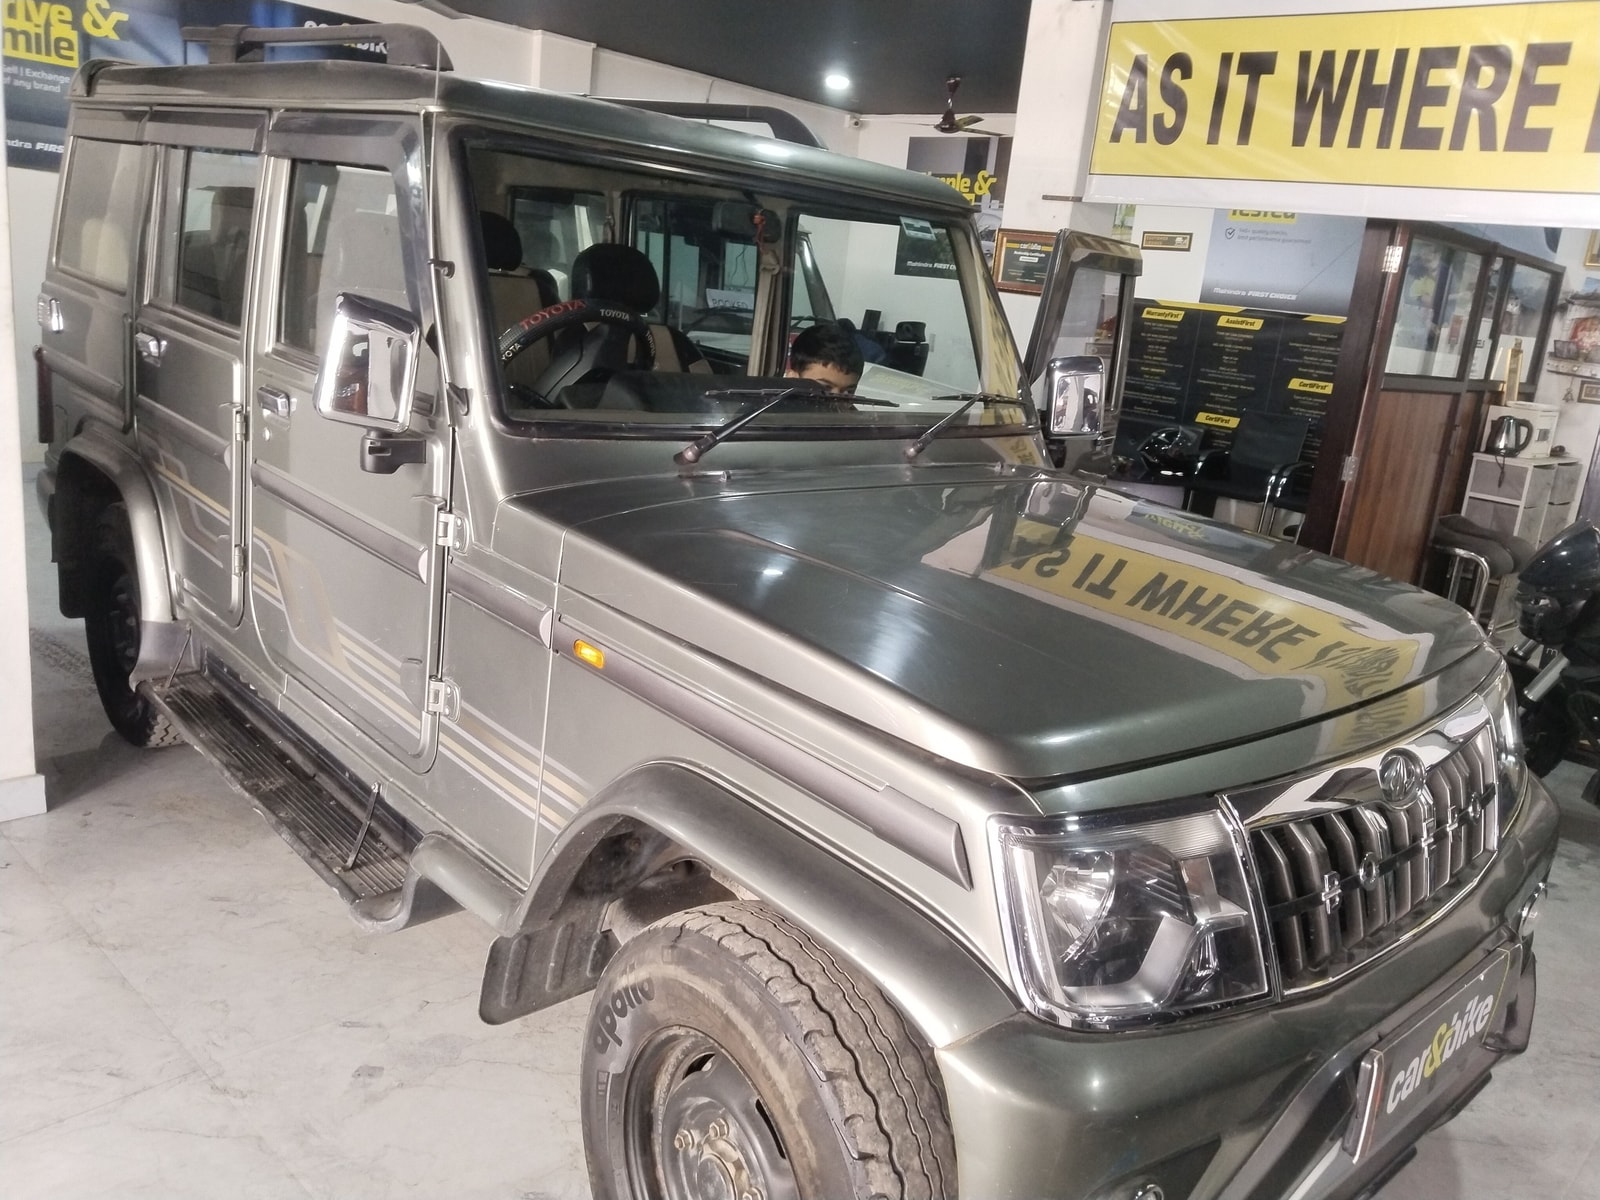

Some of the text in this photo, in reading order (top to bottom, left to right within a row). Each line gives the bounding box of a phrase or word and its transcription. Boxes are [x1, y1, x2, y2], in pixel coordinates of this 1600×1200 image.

[82, 0, 129, 40] &
[13, 79, 31, 90] any
[33, 81, 61, 93] brand
[25, 68, 71, 84] Exchange
[1110, 51, 1193, 146] AS
[1206, 51, 1278, 146] IT
[1291, 42, 1573, 153] WHERE
[974, 170, 997, 195] &
[519, 299, 588, 331] TOYOTA
[600, 308, 630, 322] TOYOTA
[593, 961, 655, 1054] apollo
[1386, 994, 1494, 1114] car&bike
